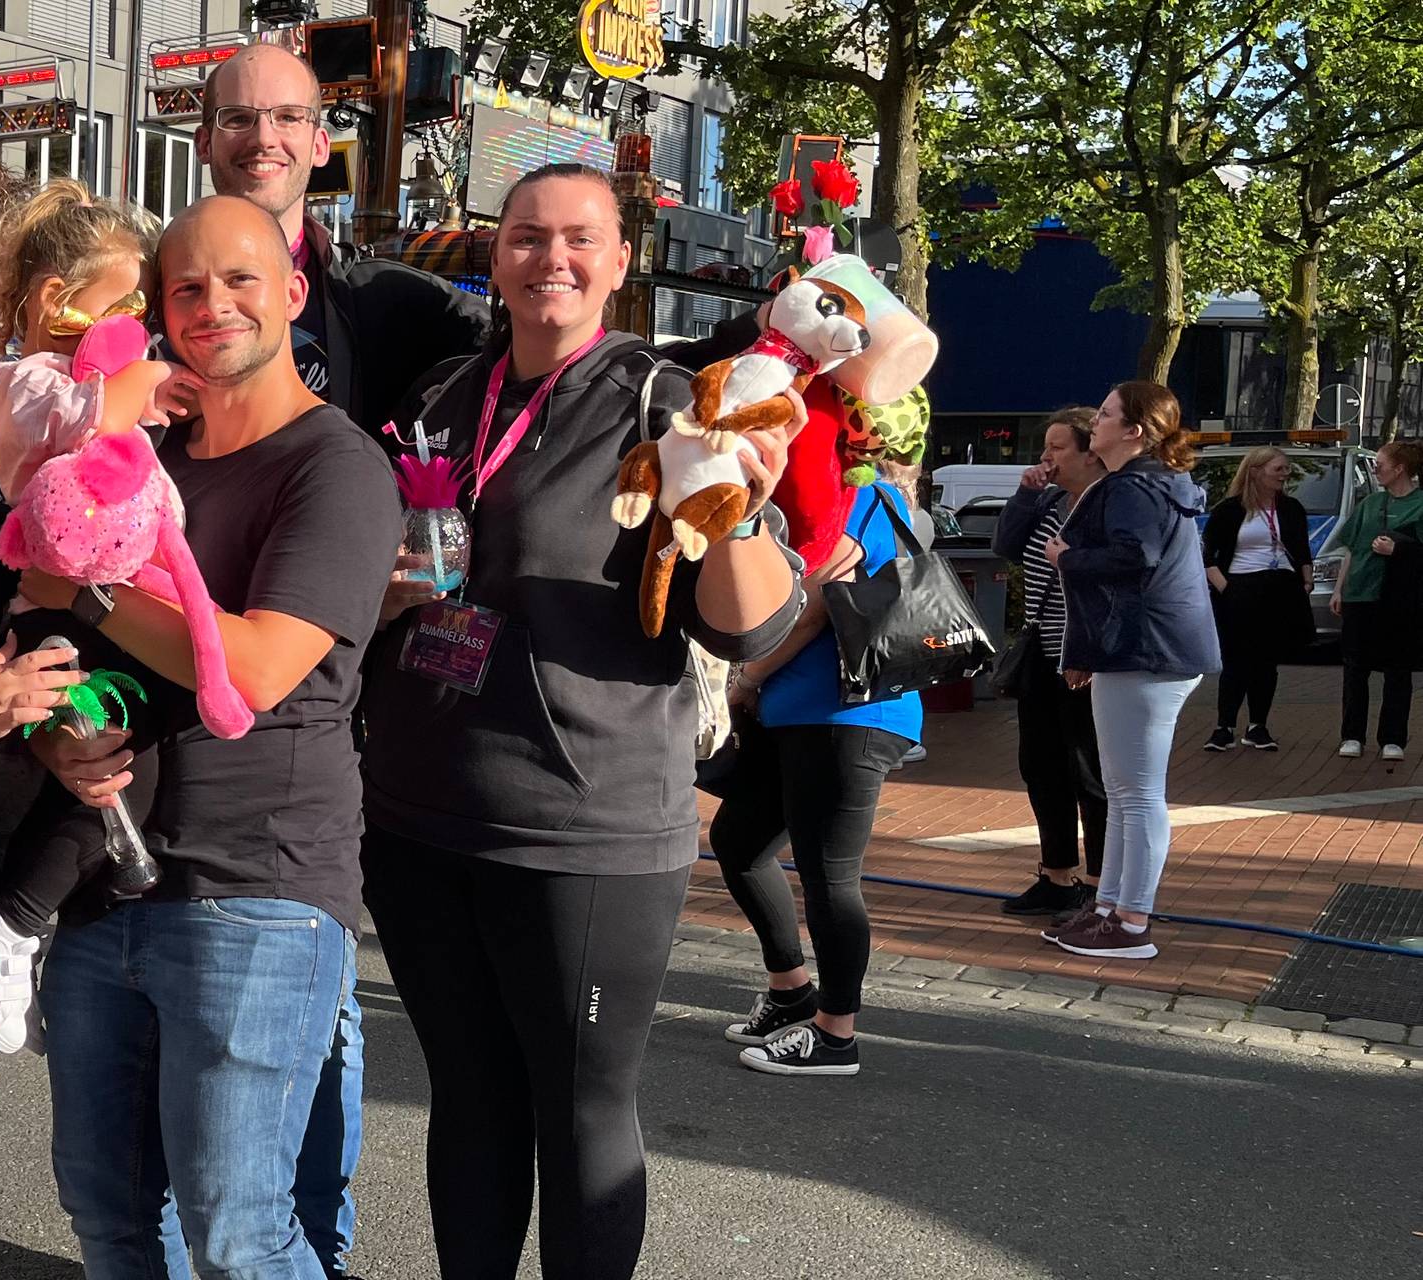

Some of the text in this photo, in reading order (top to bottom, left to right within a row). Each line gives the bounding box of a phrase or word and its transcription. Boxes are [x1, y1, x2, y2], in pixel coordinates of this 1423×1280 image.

[598, 9, 665, 70] IMPRESS
[438, 607, 471, 635] XXL
[418, 622, 486, 651] BUMMELPASS
[945, 628, 985, 646] SATU
[588, 984, 601, 1023] ARIAT
